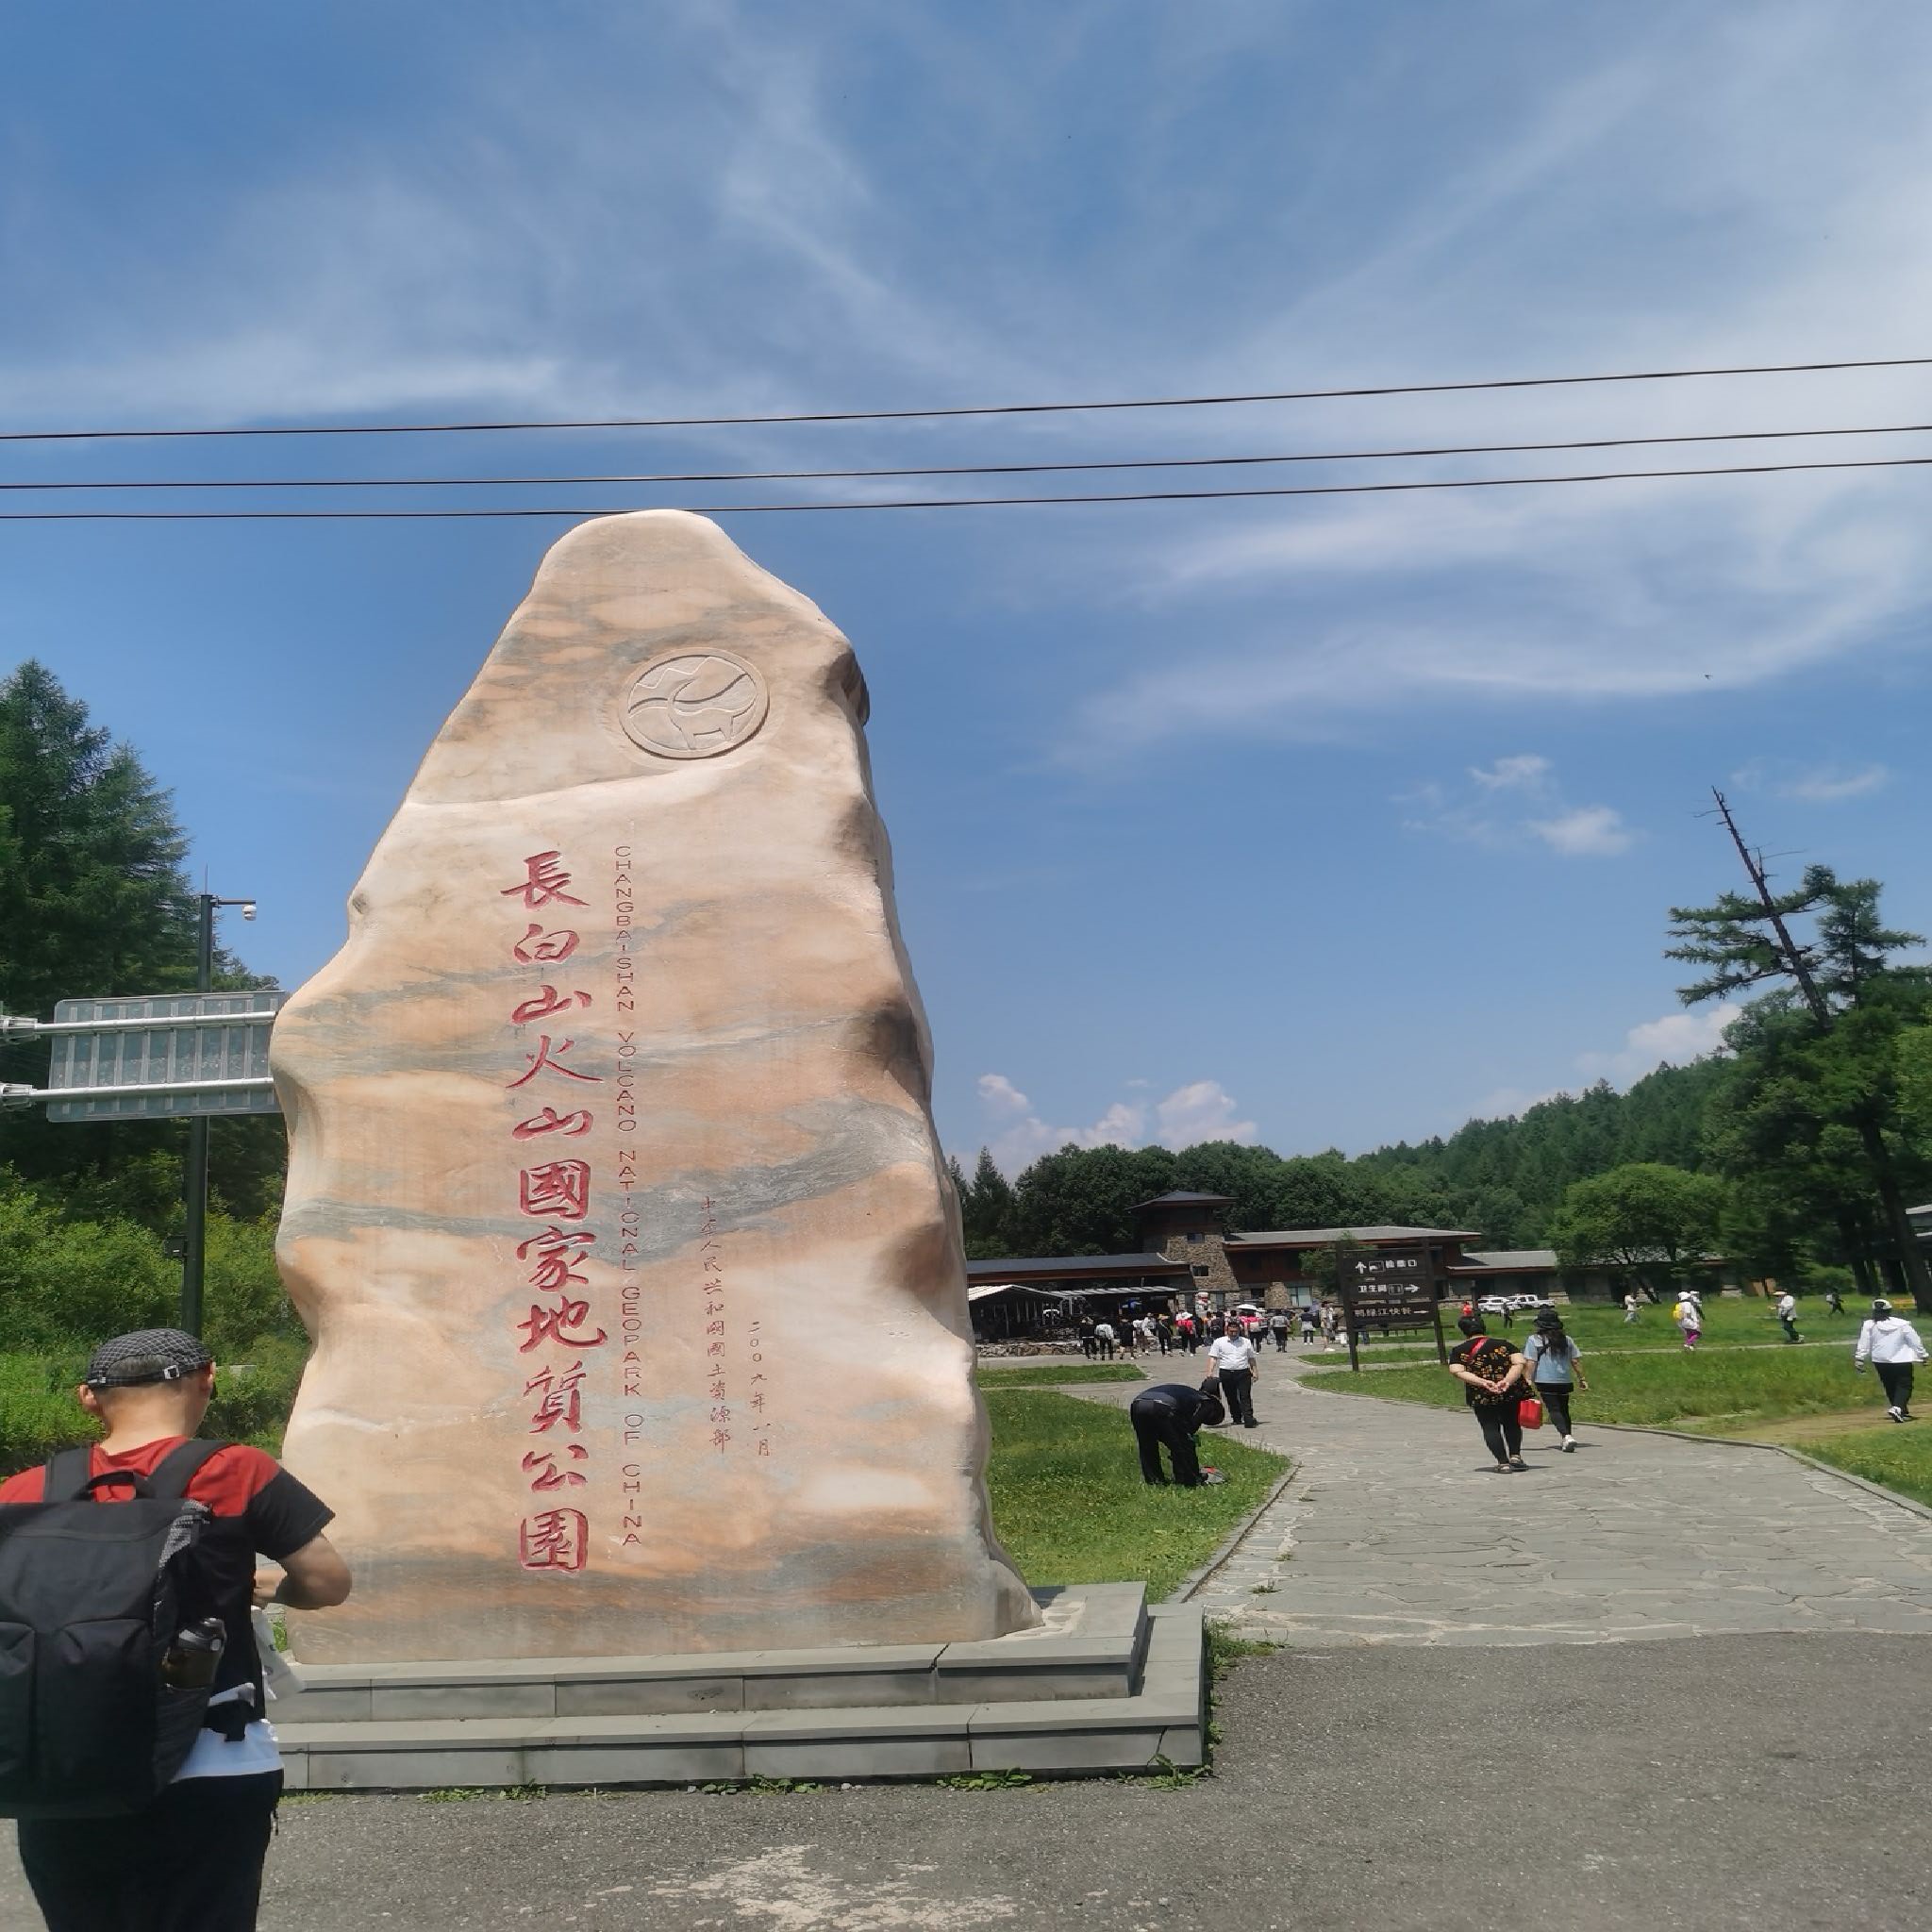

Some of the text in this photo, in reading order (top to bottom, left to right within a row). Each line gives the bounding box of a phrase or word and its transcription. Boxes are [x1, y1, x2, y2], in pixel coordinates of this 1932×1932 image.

[500, 851, 608, 1574] 長白山火山國家地質公園
[615, 846, 643, 1546] CHANGBAISHAN VOLCANO NATIONAL GEOPARK OF CHINA
[1357, 1284, 1388, 1293] 卫生间
